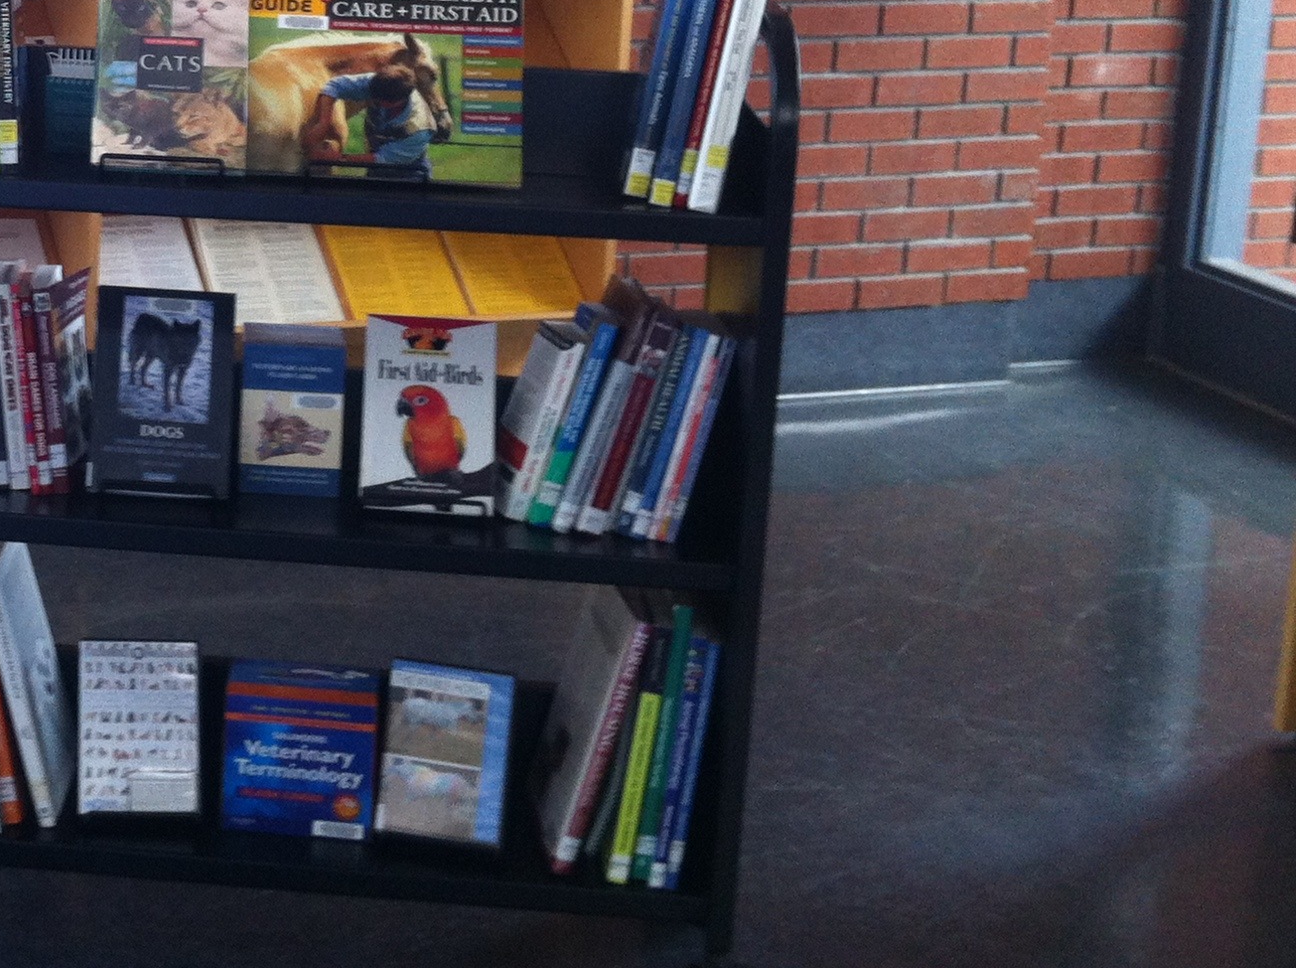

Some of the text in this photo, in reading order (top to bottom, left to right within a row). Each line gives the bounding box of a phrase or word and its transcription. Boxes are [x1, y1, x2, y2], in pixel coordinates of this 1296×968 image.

[331, 2, 394, 18] CARE
[410, 4, 475, 22] FIRST
[476, 6, 519, 23] AID
[138, 53, 202, 74] CATS
[139, 424, 185, 439] DOGS
[243, 738, 355, 770] Veterinary
[232, 757, 364, 790] Terminology
